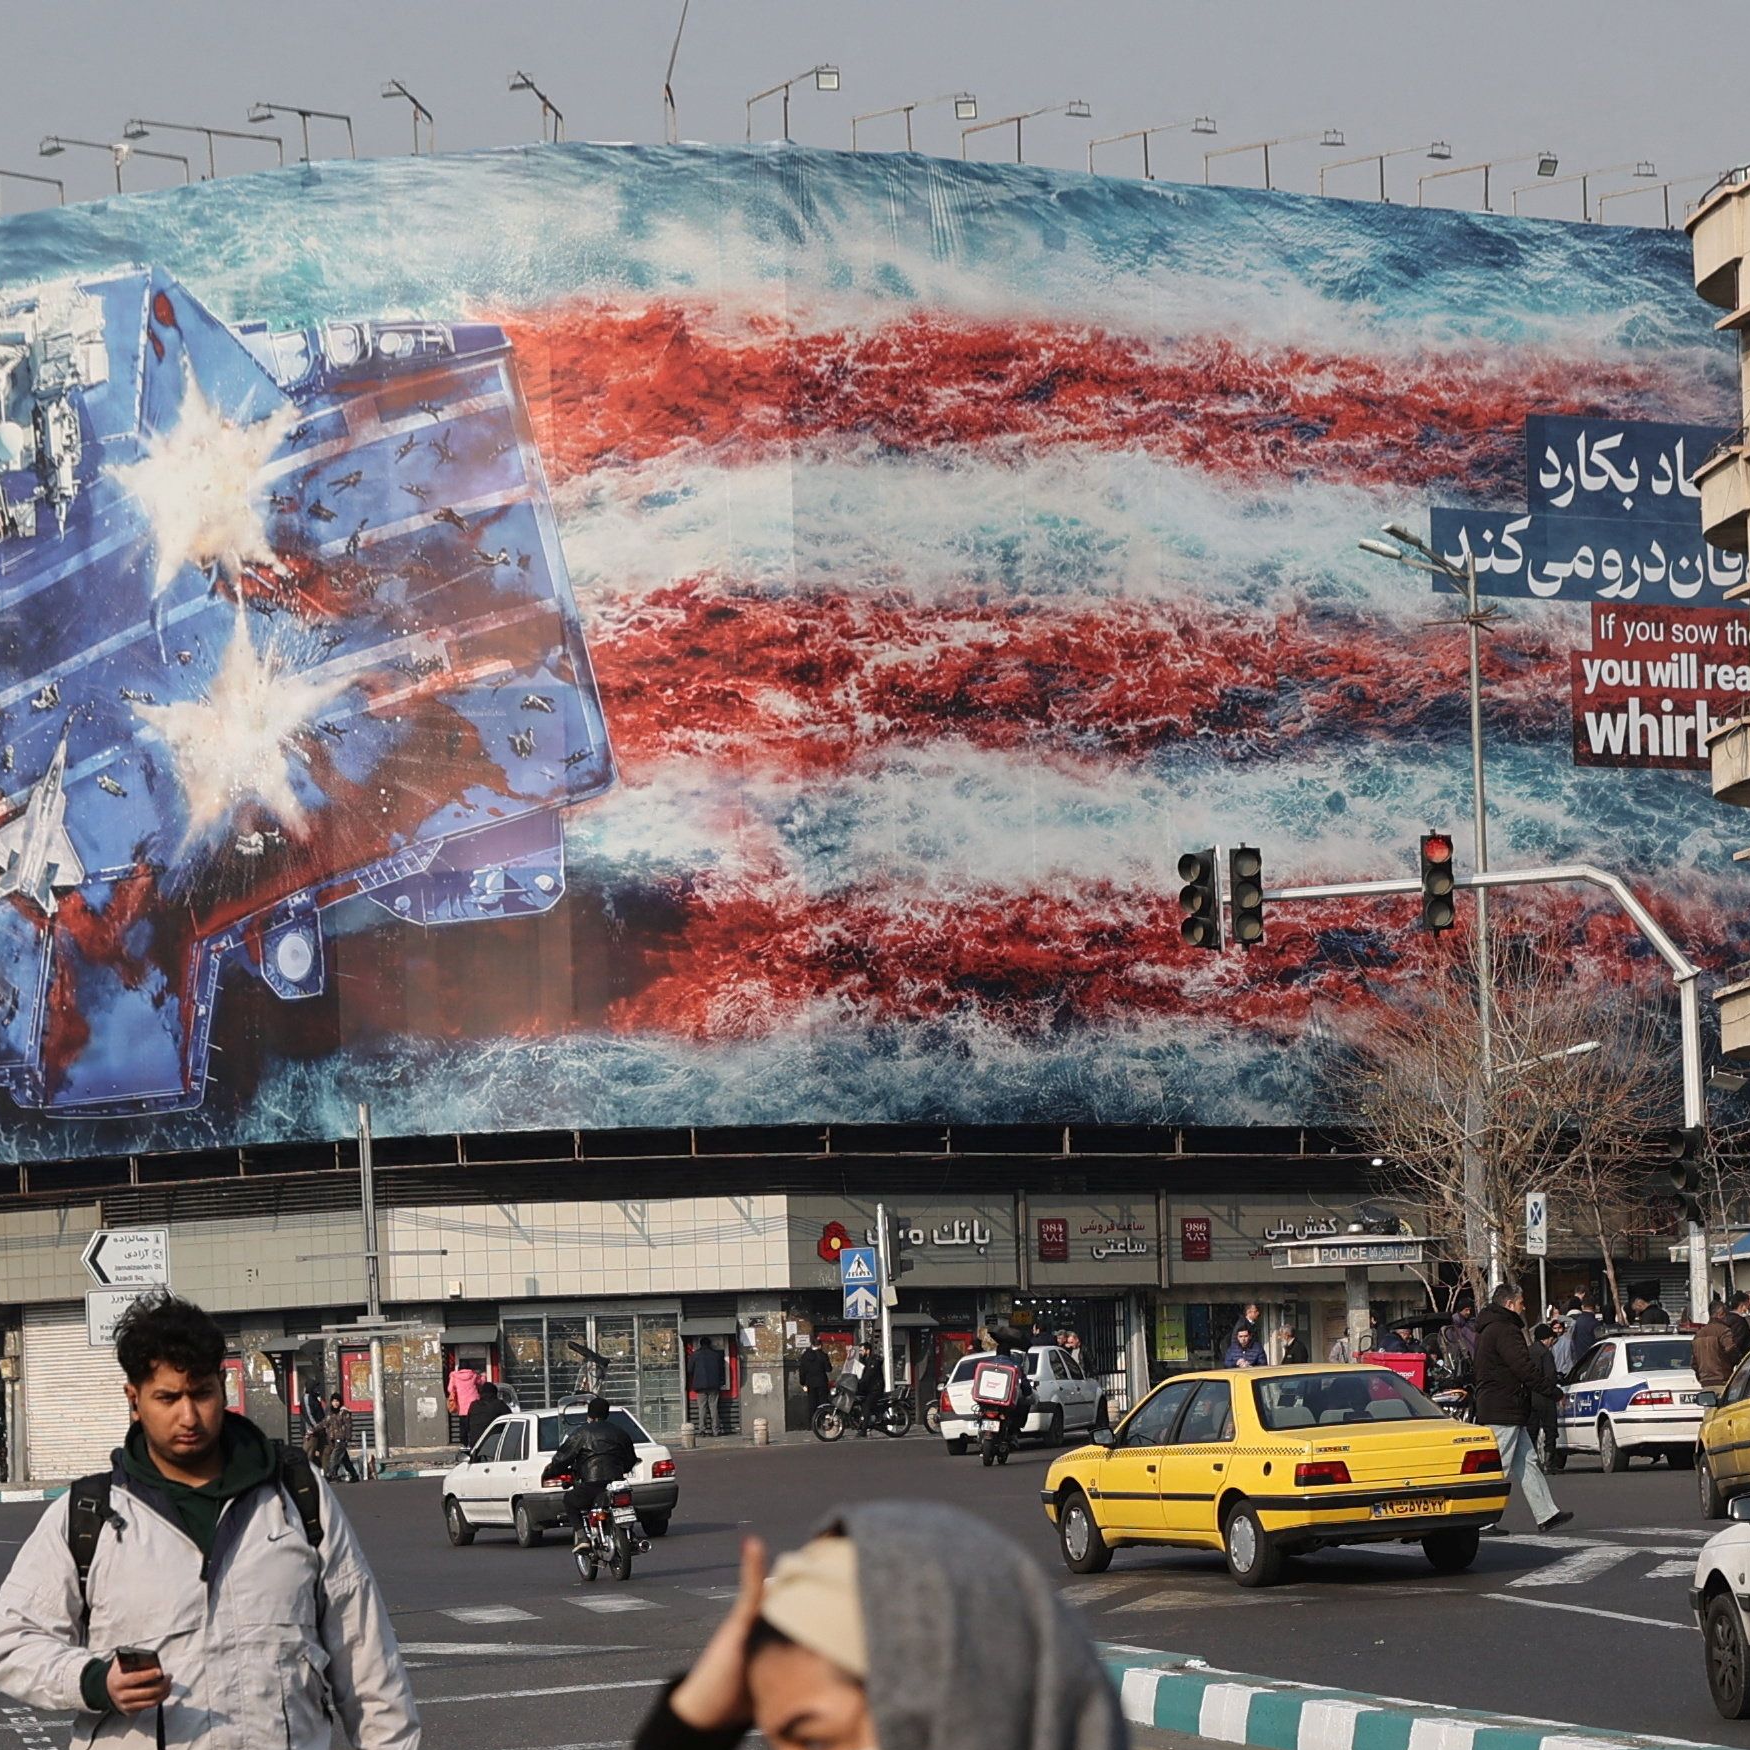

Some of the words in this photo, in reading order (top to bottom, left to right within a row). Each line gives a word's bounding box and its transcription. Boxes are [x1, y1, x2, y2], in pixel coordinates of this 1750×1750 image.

[1539, 430, 1639, 511] بکارد
[1600, 613, 1615, 640] If
[1623, 621, 1664, 647] you
[1671, 624, 1717, 645] sow
[1725, 620, 1750, 647] th
[1582, 657, 1640, 694] you
[1647, 653, 1697, 689] will
[1585, 697, 1734, 758] whirl
[932, 1219, 990, 1255] بانک
[1042, 1223, 1063, 1233] 984
[1080, 1219, 1115, 1234] فروشی
[1115, 1220, 1145, 1232] ساعت
[1185, 1222, 1207, 1232] 986
[1264, 1218, 1295, 1240] ملی
[1296, 1215, 1338, 1240] کفش
[113, 1234, 149, 1245] جمالزاده
[1092, 1236, 1147, 1260] ساعتی
[124, 1248, 149, 1260] آزادی
[1321, 1247, 1368, 1261] POLICE
